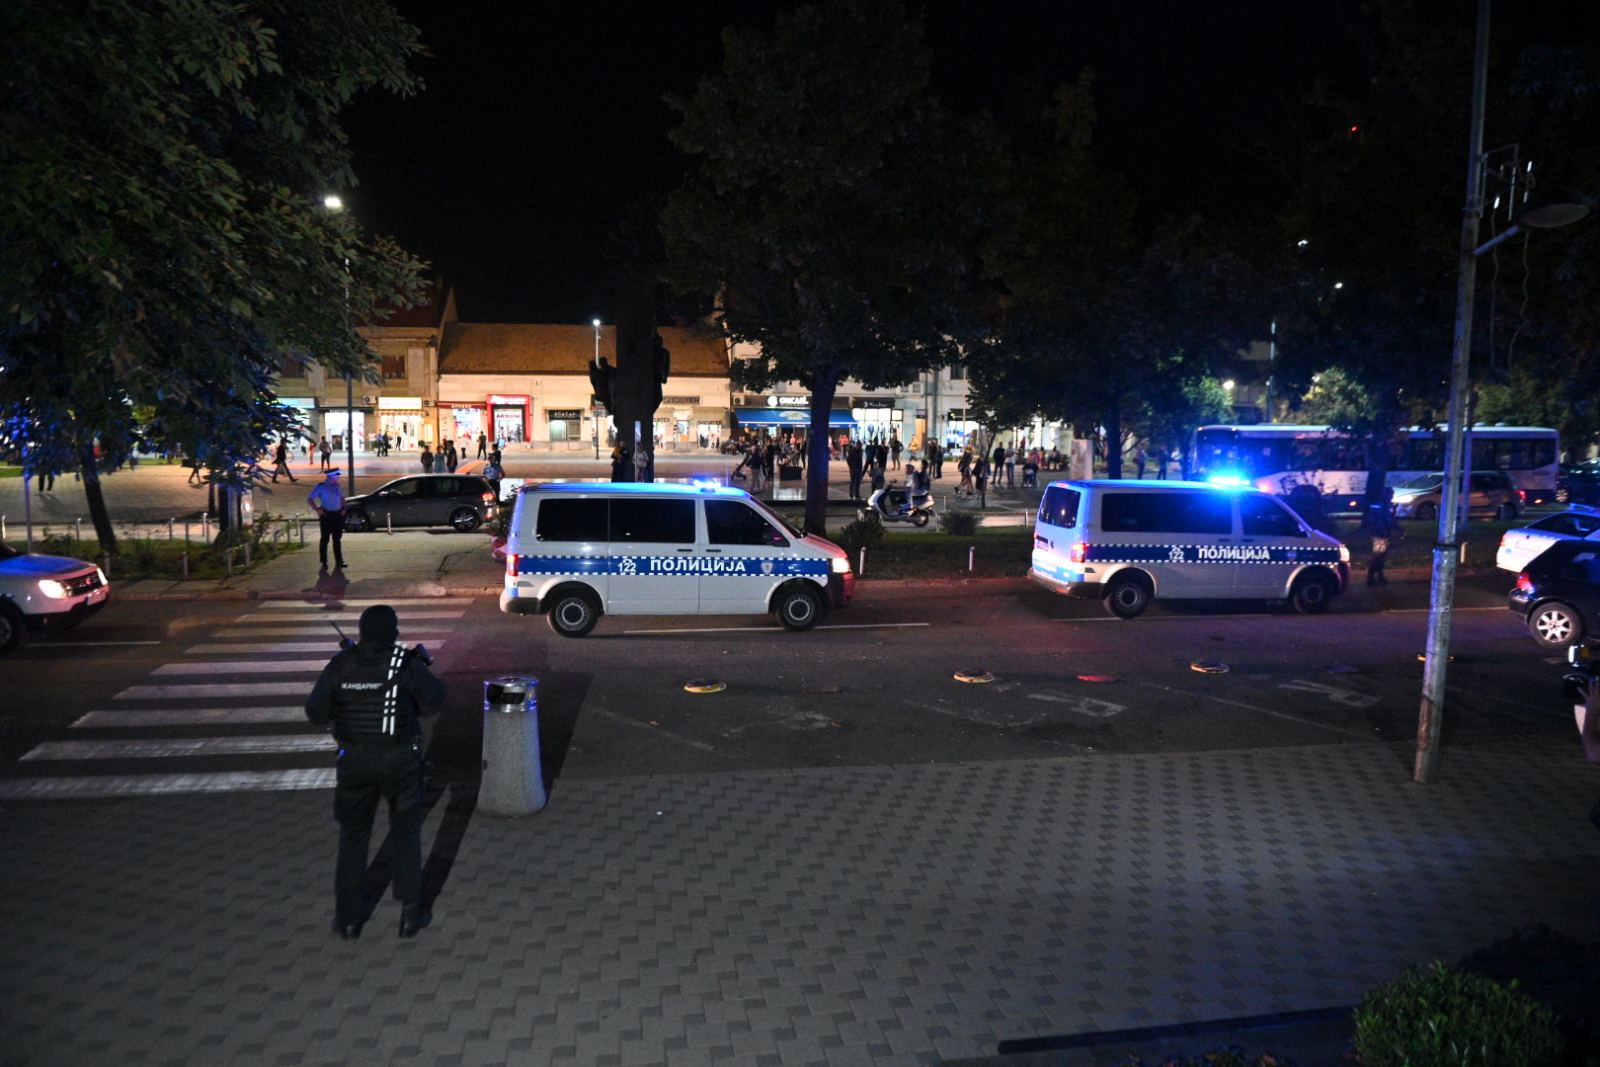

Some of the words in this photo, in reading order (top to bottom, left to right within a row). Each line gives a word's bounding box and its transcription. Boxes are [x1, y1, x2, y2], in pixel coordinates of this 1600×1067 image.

[1168, 551, 1184, 560] 122
[1198, 548, 1270, 562] ПОЛИЦИЈА
[618, 562, 636, 573] 122
[650, 559, 746, 573] ПОЛИЦИЈА
